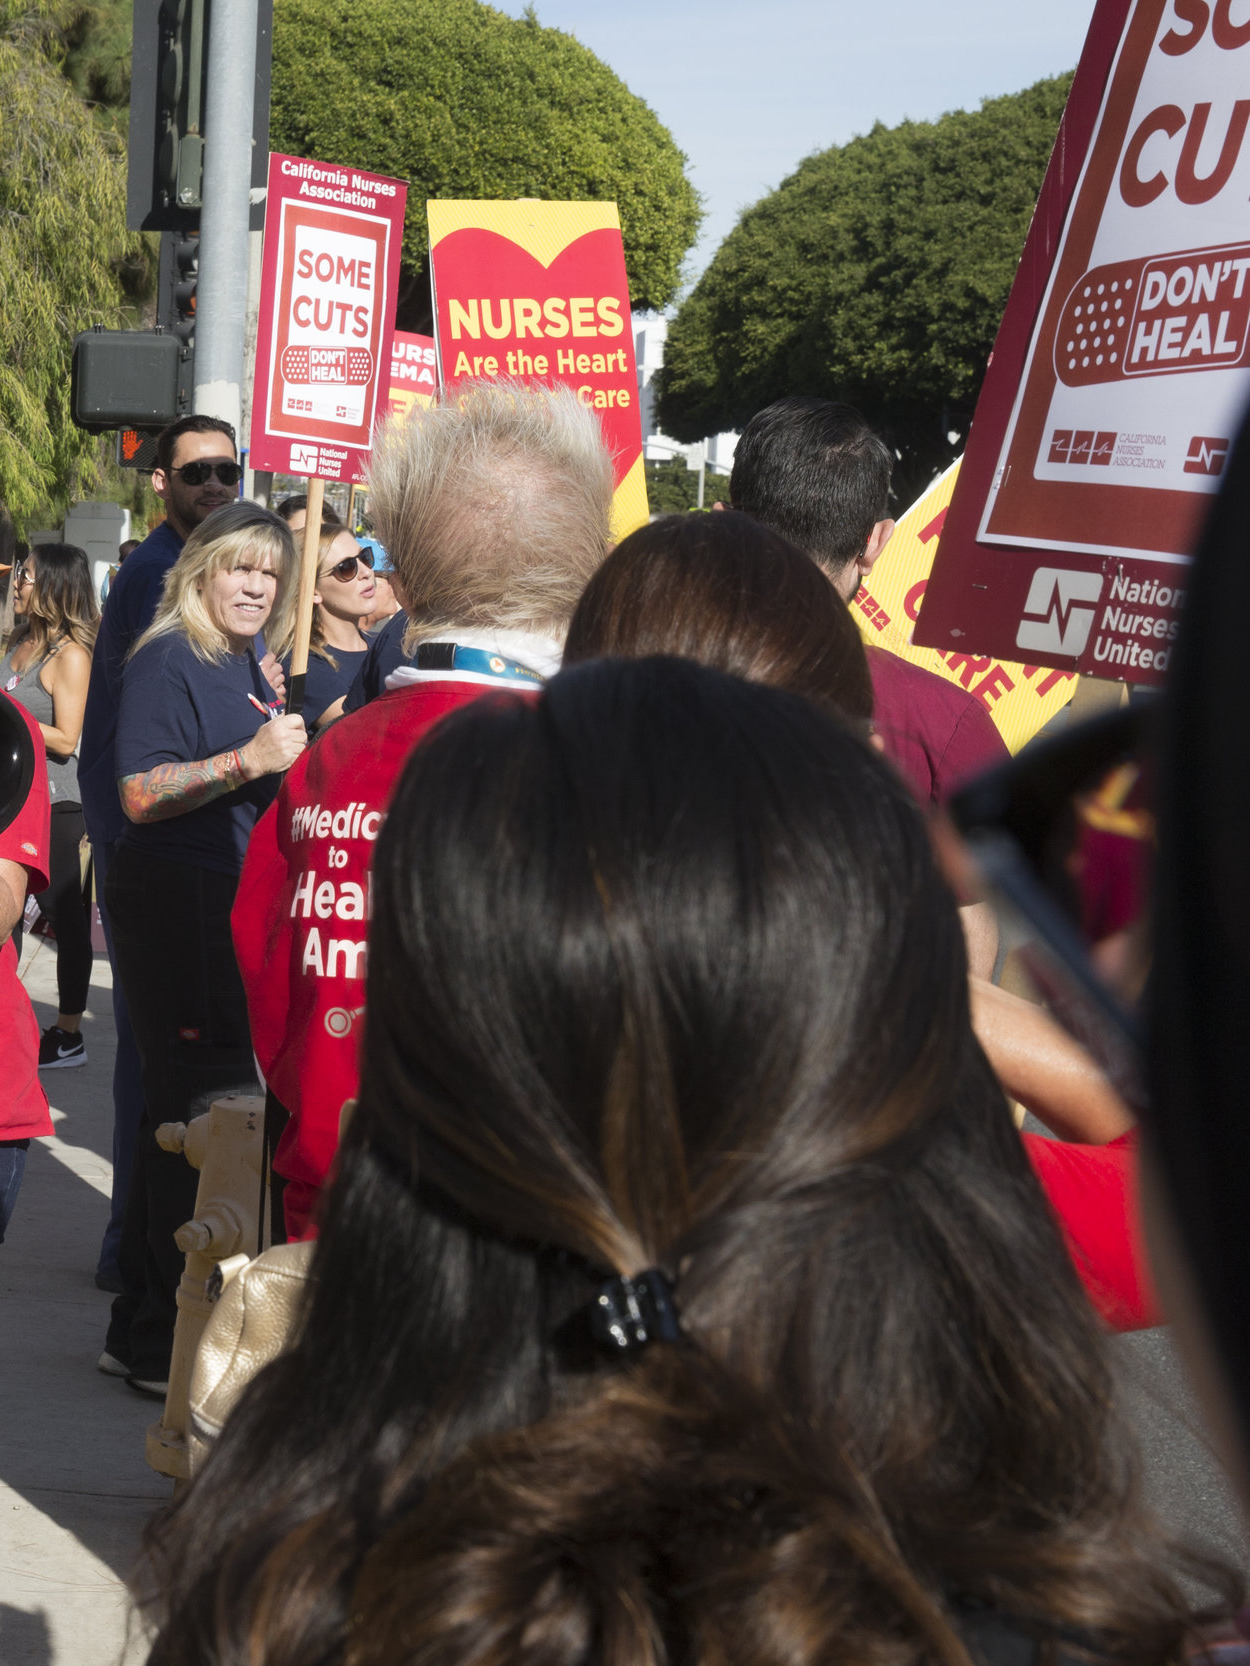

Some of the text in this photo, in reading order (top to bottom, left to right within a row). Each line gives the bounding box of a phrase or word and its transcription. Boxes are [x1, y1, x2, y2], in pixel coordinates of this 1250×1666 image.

[1119, 99, 1250, 209] CU
[281, 160, 396, 197] California Nurses
[299, 181, 376, 209] Association
[297, 249, 371, 290] SOME
[1141, 257, 1250, 311] DON'T
[293, 295, 369, 338] CUTS
[449, 296, 623, 339] NURSES
[1131, 310, 1238, 364] HEAL
[311, 350, 345, 364] DON'T
[391, 341, 435, 366] URS
[454, 349, 628, 377] Are the Heart
[311, 366, 345, 381] HEAL
[390, 362, 434, 385] EMA
[578, 385, 630, 409] Care
[320, 447, 348, 460] National
[1115, 445, 1144, 456] NURSES
[1118, 433, 1167, 446] CALIFORNIA
[318, 467, 341, 478] United
[319, 457, 342, 468] Nurses
[1112, 456, 1166, 470] ASSOCIATION
[1109, 575, 1185, 609] Nation
[1100, 605, 1179, 640] Nurses
[1093, 636, 1171, 671] United
[291, 802, 388, 843] #Medic
[328, 846, 348, 868] to
[302, 927, 368, 979] Am
